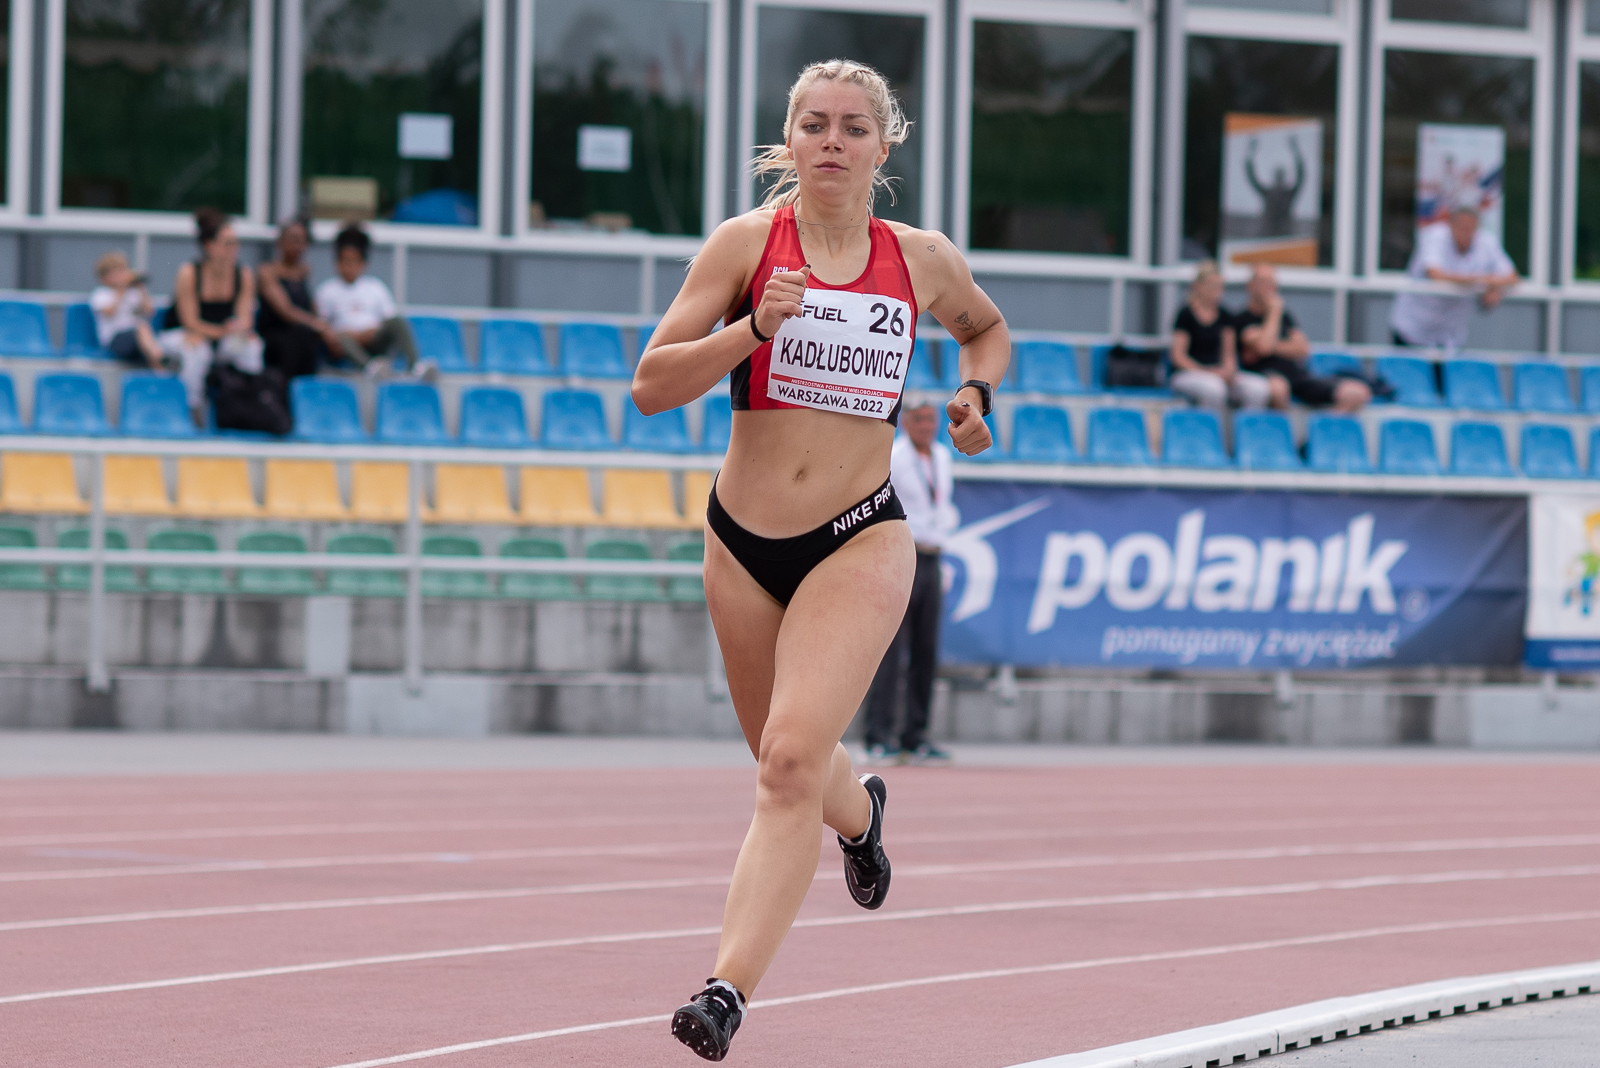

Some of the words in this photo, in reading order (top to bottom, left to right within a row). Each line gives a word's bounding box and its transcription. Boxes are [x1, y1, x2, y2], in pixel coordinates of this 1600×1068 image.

[868, 302, 905, 337] 26
[780, 336, 903, 380] KADŁUBOWICZ
[777, 384, 849, 409] WARSZAWA
[852, 398, 883, 413] 2022
[791, 378, 824, 389] MISTRZOSTWA
[849, 388, 884, 397] WIELOBOJACH
[833, 501, 873, 535] NIKE
[1027, 507, 1408, 634] polanik
[1103, 626, 1260, 665] pomagamy
[1263, 622, 1399, 666] zwyciężać
